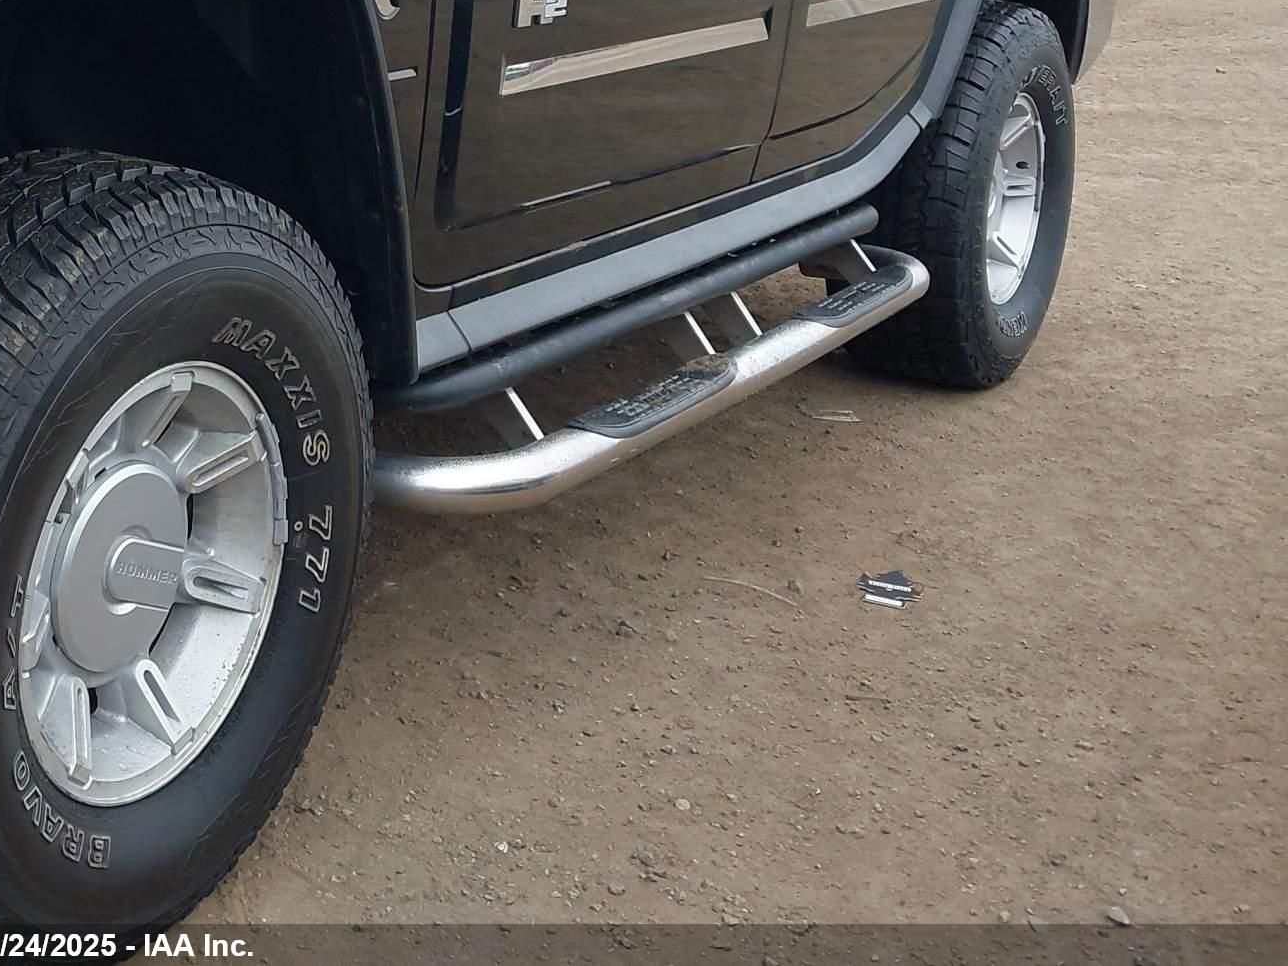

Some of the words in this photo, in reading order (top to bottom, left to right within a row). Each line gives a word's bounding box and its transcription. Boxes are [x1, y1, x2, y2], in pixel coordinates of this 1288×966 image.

[211, 316, 331, 466] MAXXIS
[297, 504, 333, 613] 771
[114, 561, 179, 586] HUMMER
[12, 749, 112, 869] BRAVO
